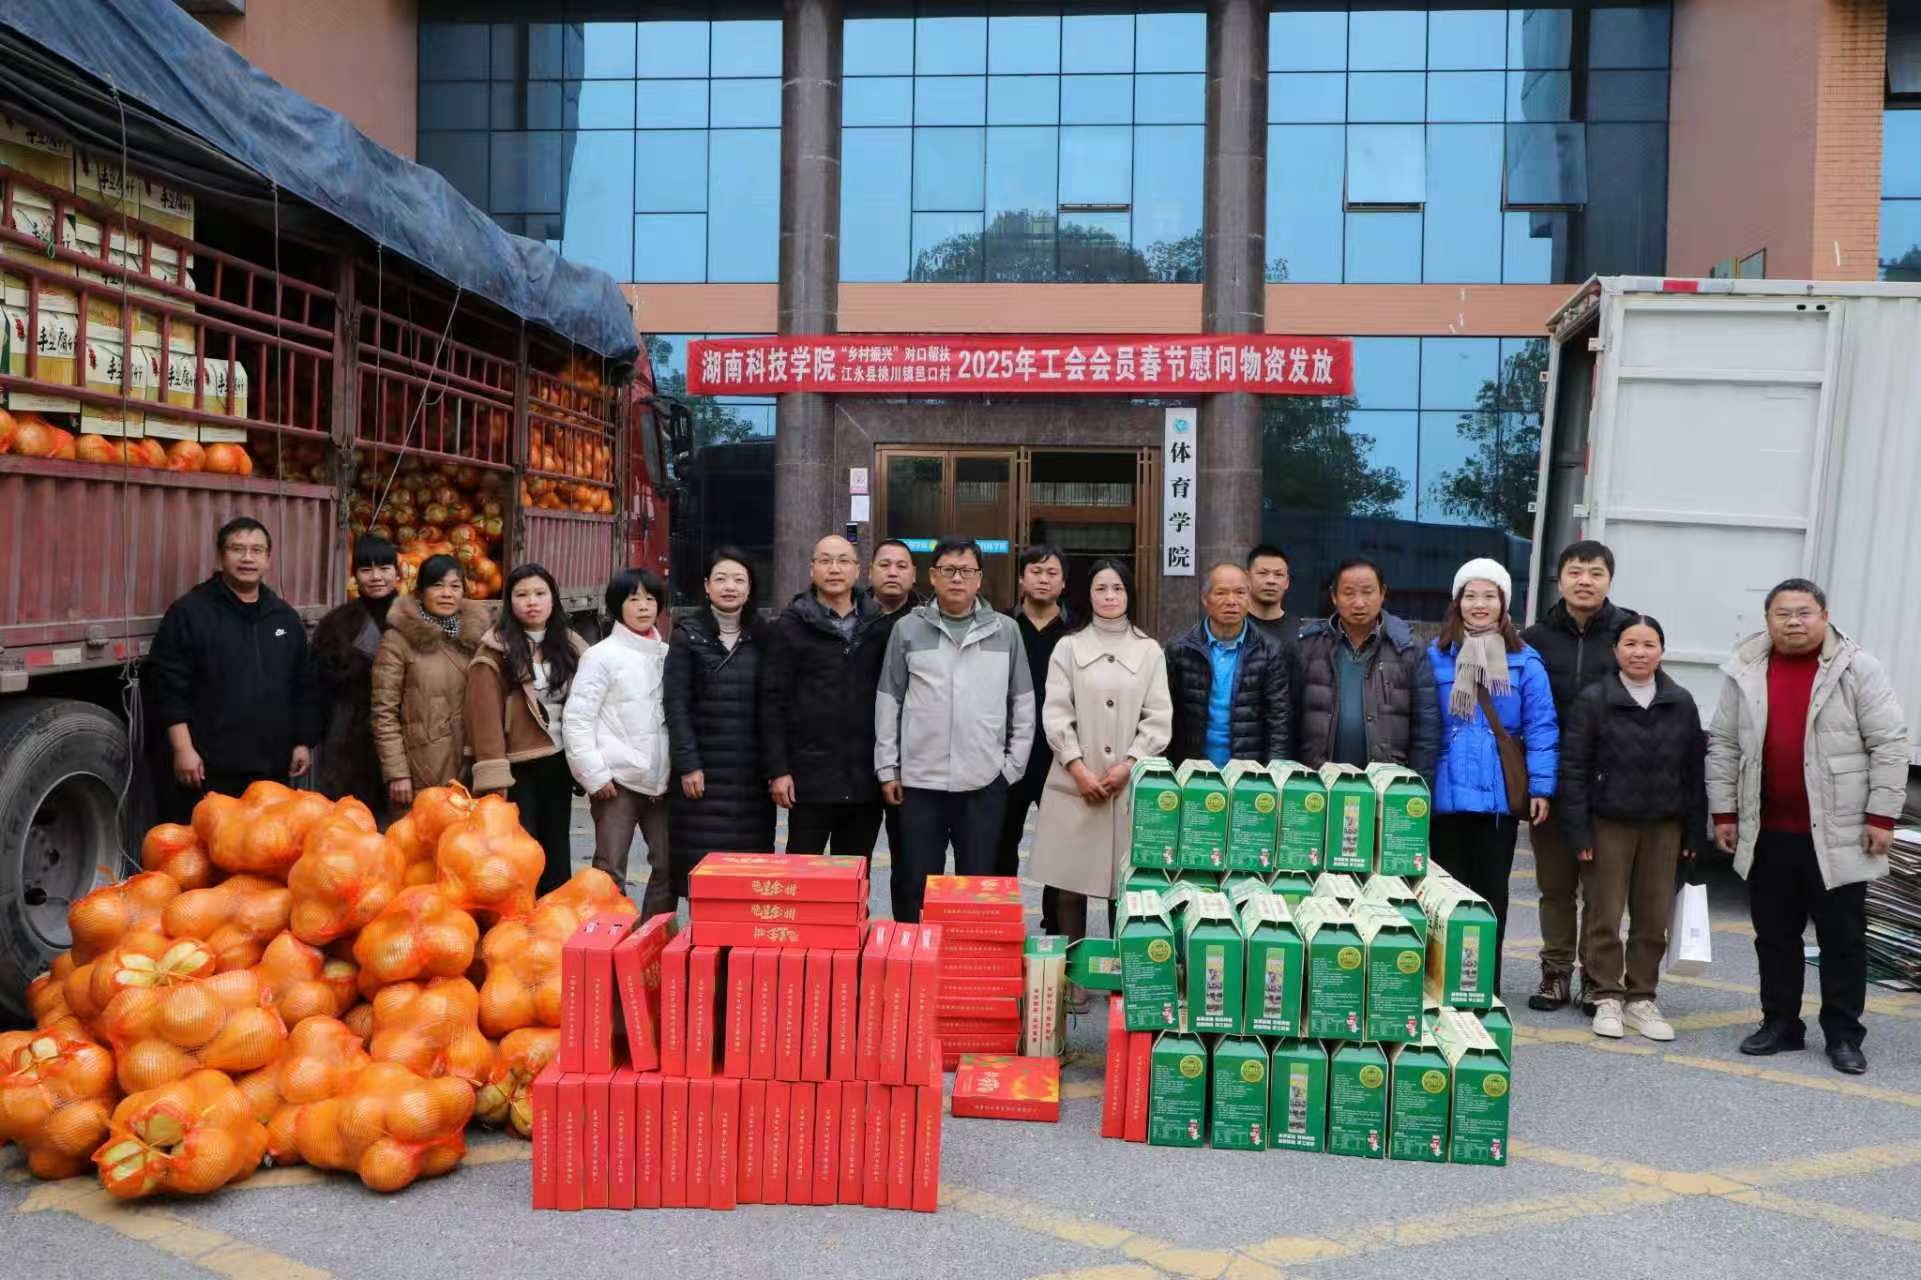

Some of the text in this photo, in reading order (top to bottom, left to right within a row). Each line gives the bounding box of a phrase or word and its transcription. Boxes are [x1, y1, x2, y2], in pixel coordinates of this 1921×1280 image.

[702, 346, 836, 384] 湖南科技学院
[904, 345, 951, 362] 对口帮扶
[958, 346, 1334, 384] 2025年工会会员春节慰问物资发放
[1168, 441, 1191, 568] 体育学院
